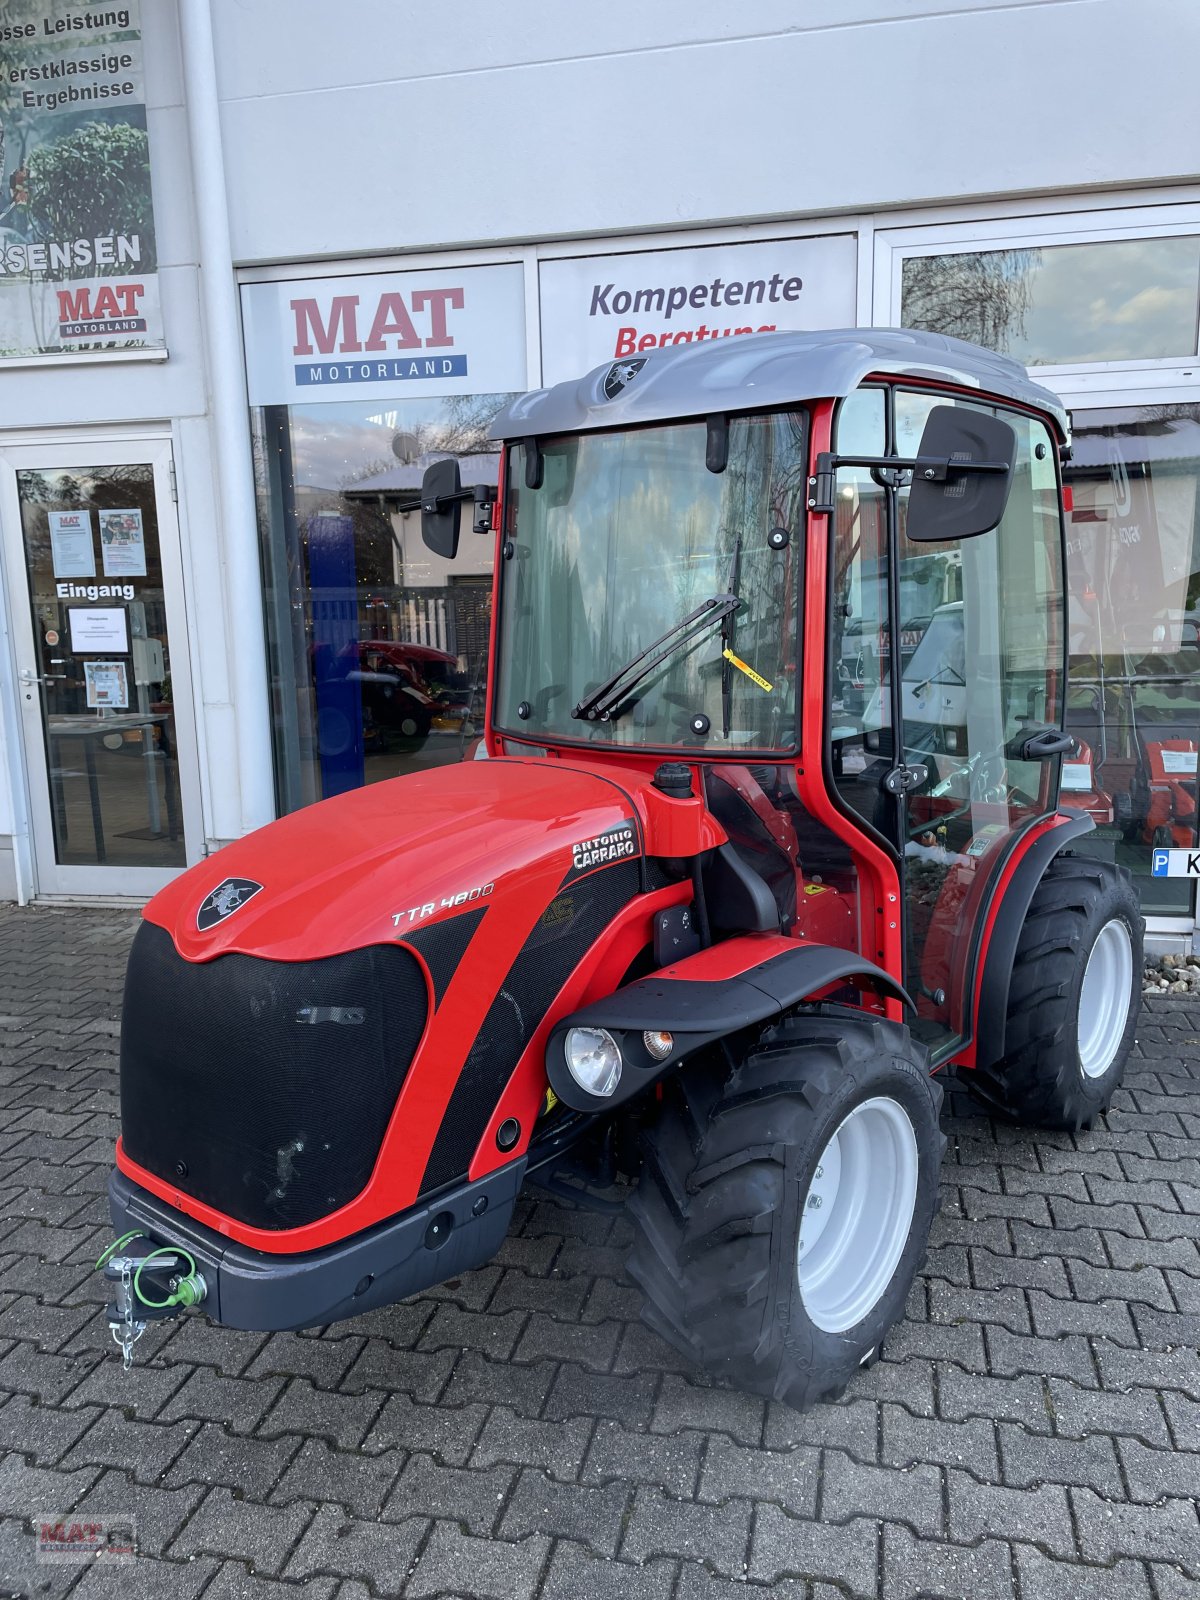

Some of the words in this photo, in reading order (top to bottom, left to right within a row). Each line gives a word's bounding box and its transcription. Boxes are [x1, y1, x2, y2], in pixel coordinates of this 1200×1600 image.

[43, 10, 130, 36] Leistung
[10, 54, 132, 83] erstklassige
[23, 81, 134, 111] Ergebnisse
[56, 284, 145, 323] MAT
[589, 272, 803, 319] Kompetente
[66, 320, 138, 334] MOTORLAND
[290, 287, 465, 356] MAT
[310, 359, 453, 381] MOTORLAND
[56, 582, 135, 601] Eingang
[572, 829, 633, 855] ANTONIO
[573, 840, 634, 870] CARRARO
[1155, 855, 1169, 871] P
[391, 902, 436, 927] TTR
[440, 882, 495, 908] 4800
